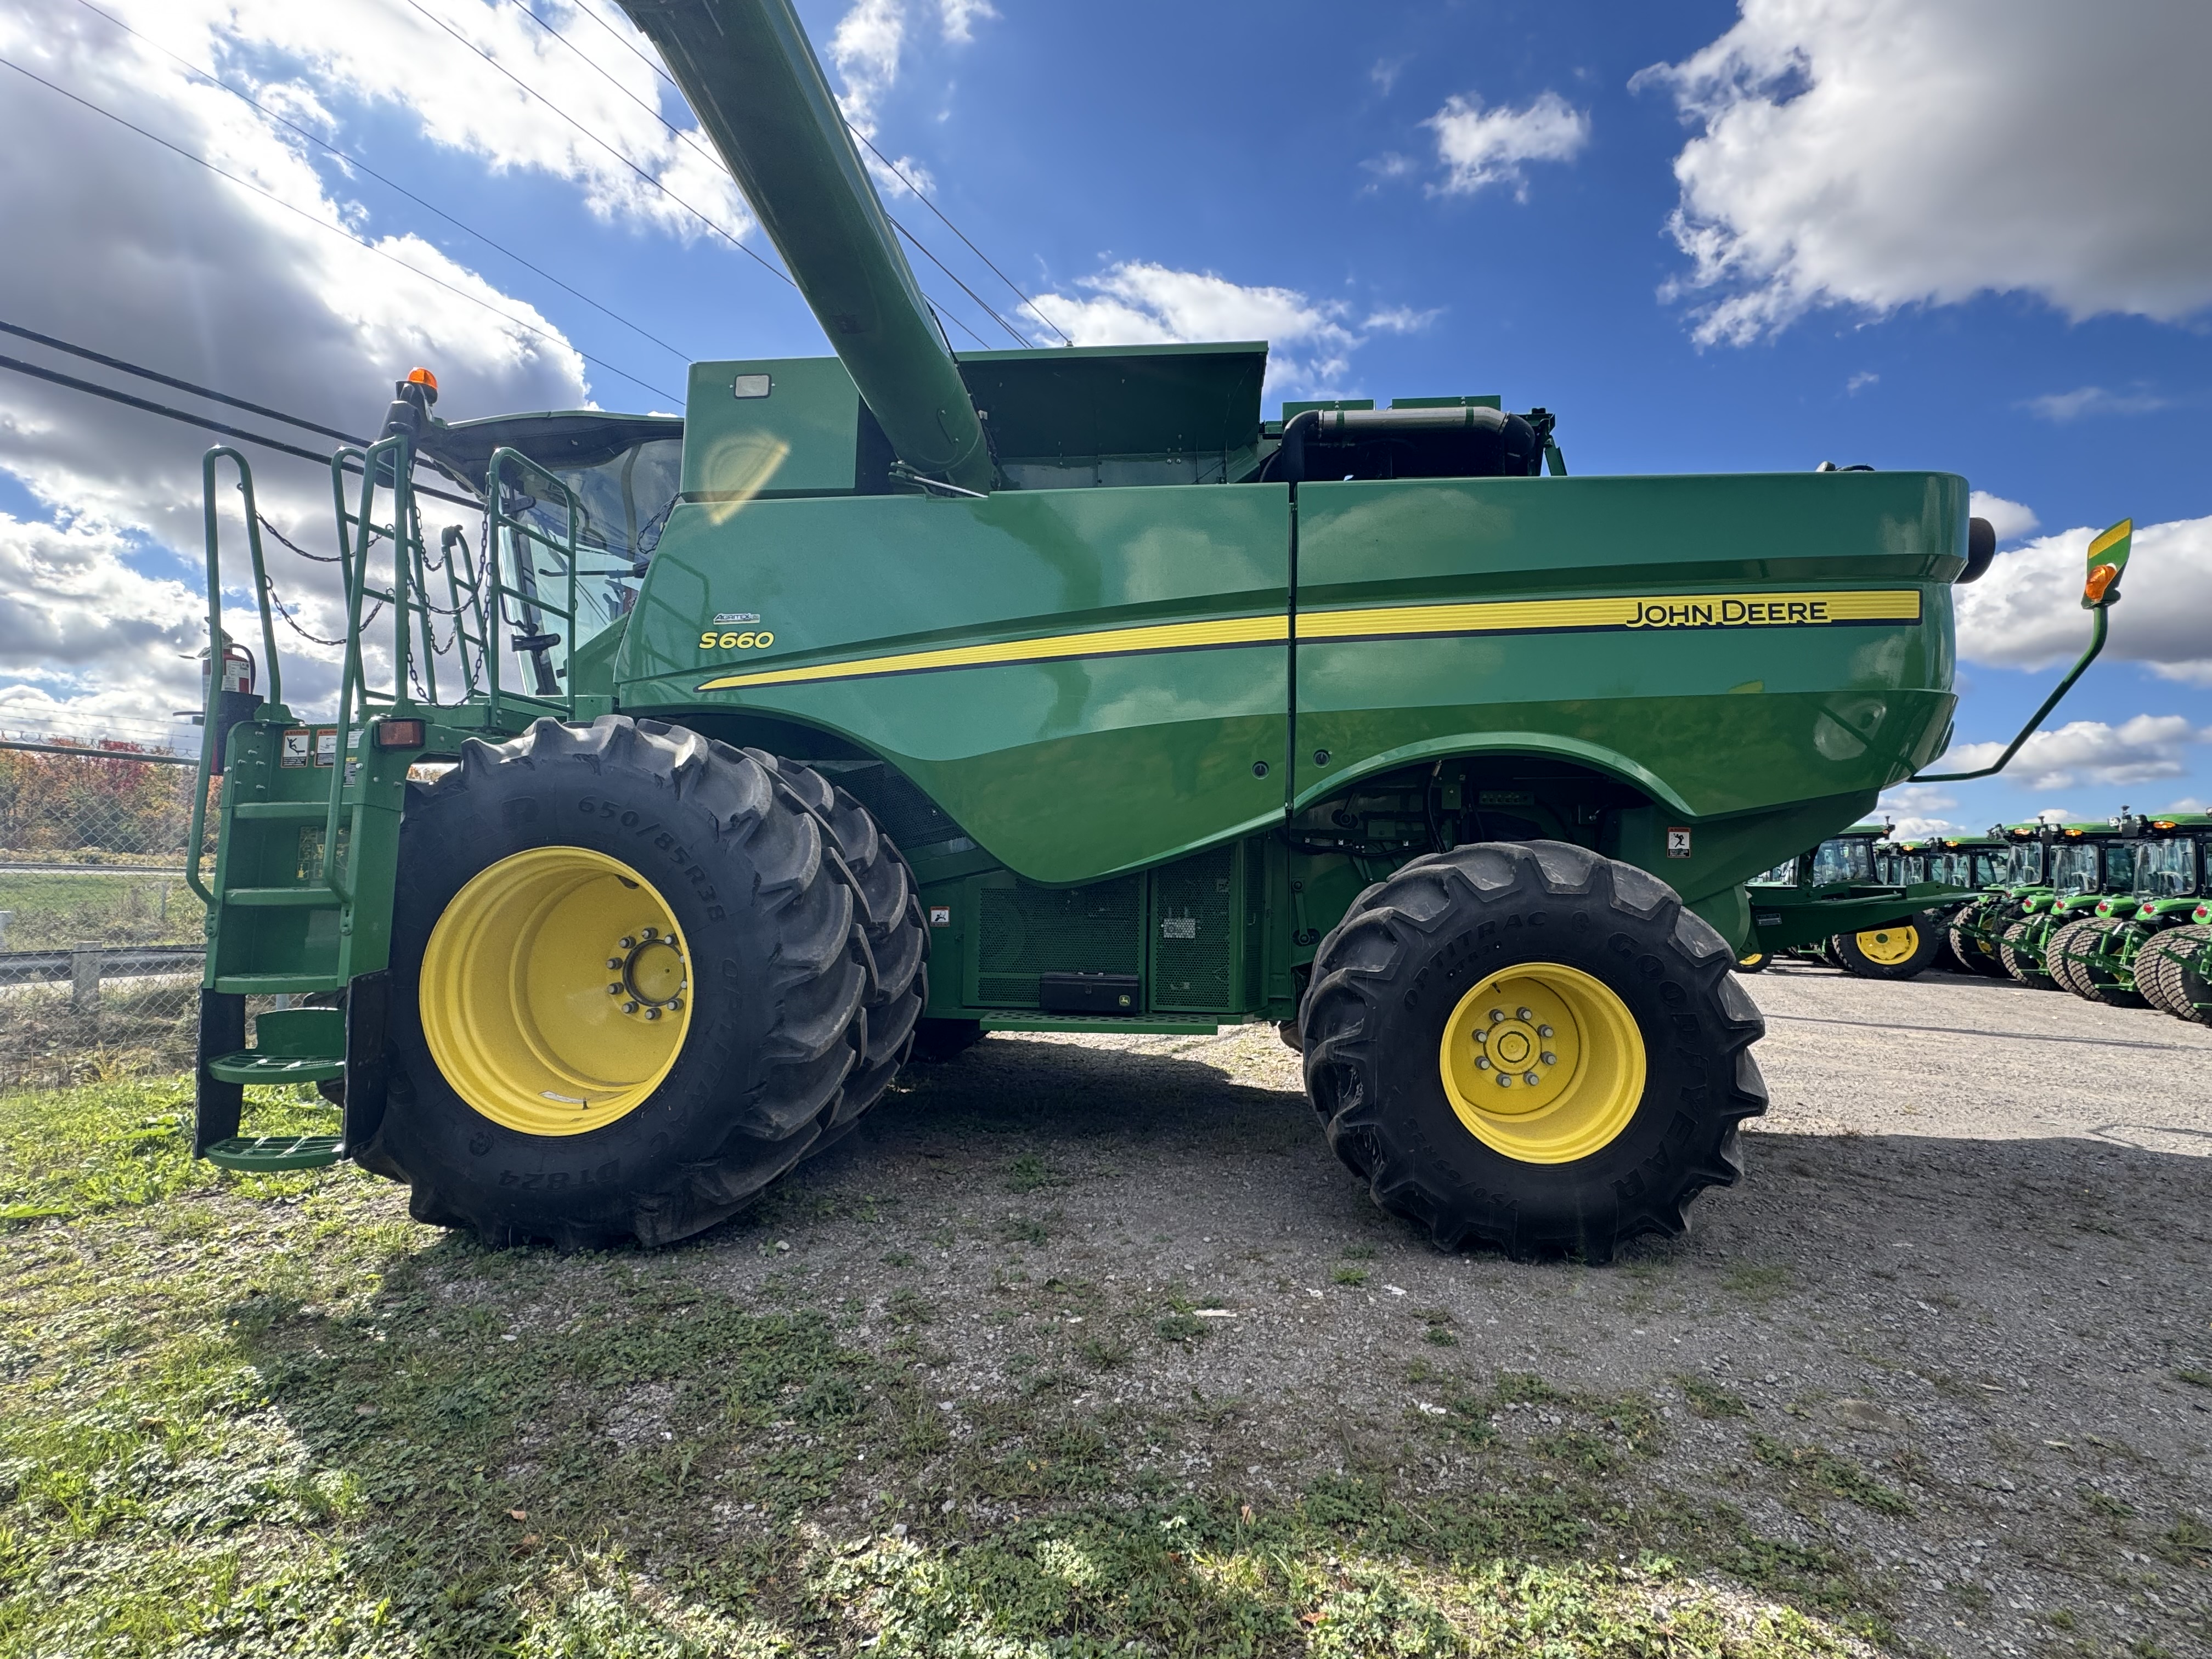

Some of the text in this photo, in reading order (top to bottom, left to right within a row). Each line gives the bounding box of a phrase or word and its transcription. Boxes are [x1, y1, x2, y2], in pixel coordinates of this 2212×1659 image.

[699, 631, 774, 649] S660
[1627, 600, 1828, 624] JOHN DEERE
[577, 795, 727, 923] 650/85R38
[1403, 911, 1548, 1013] OPTITRAC
[1607, 932, 1709, 1203] GOODYEAR
